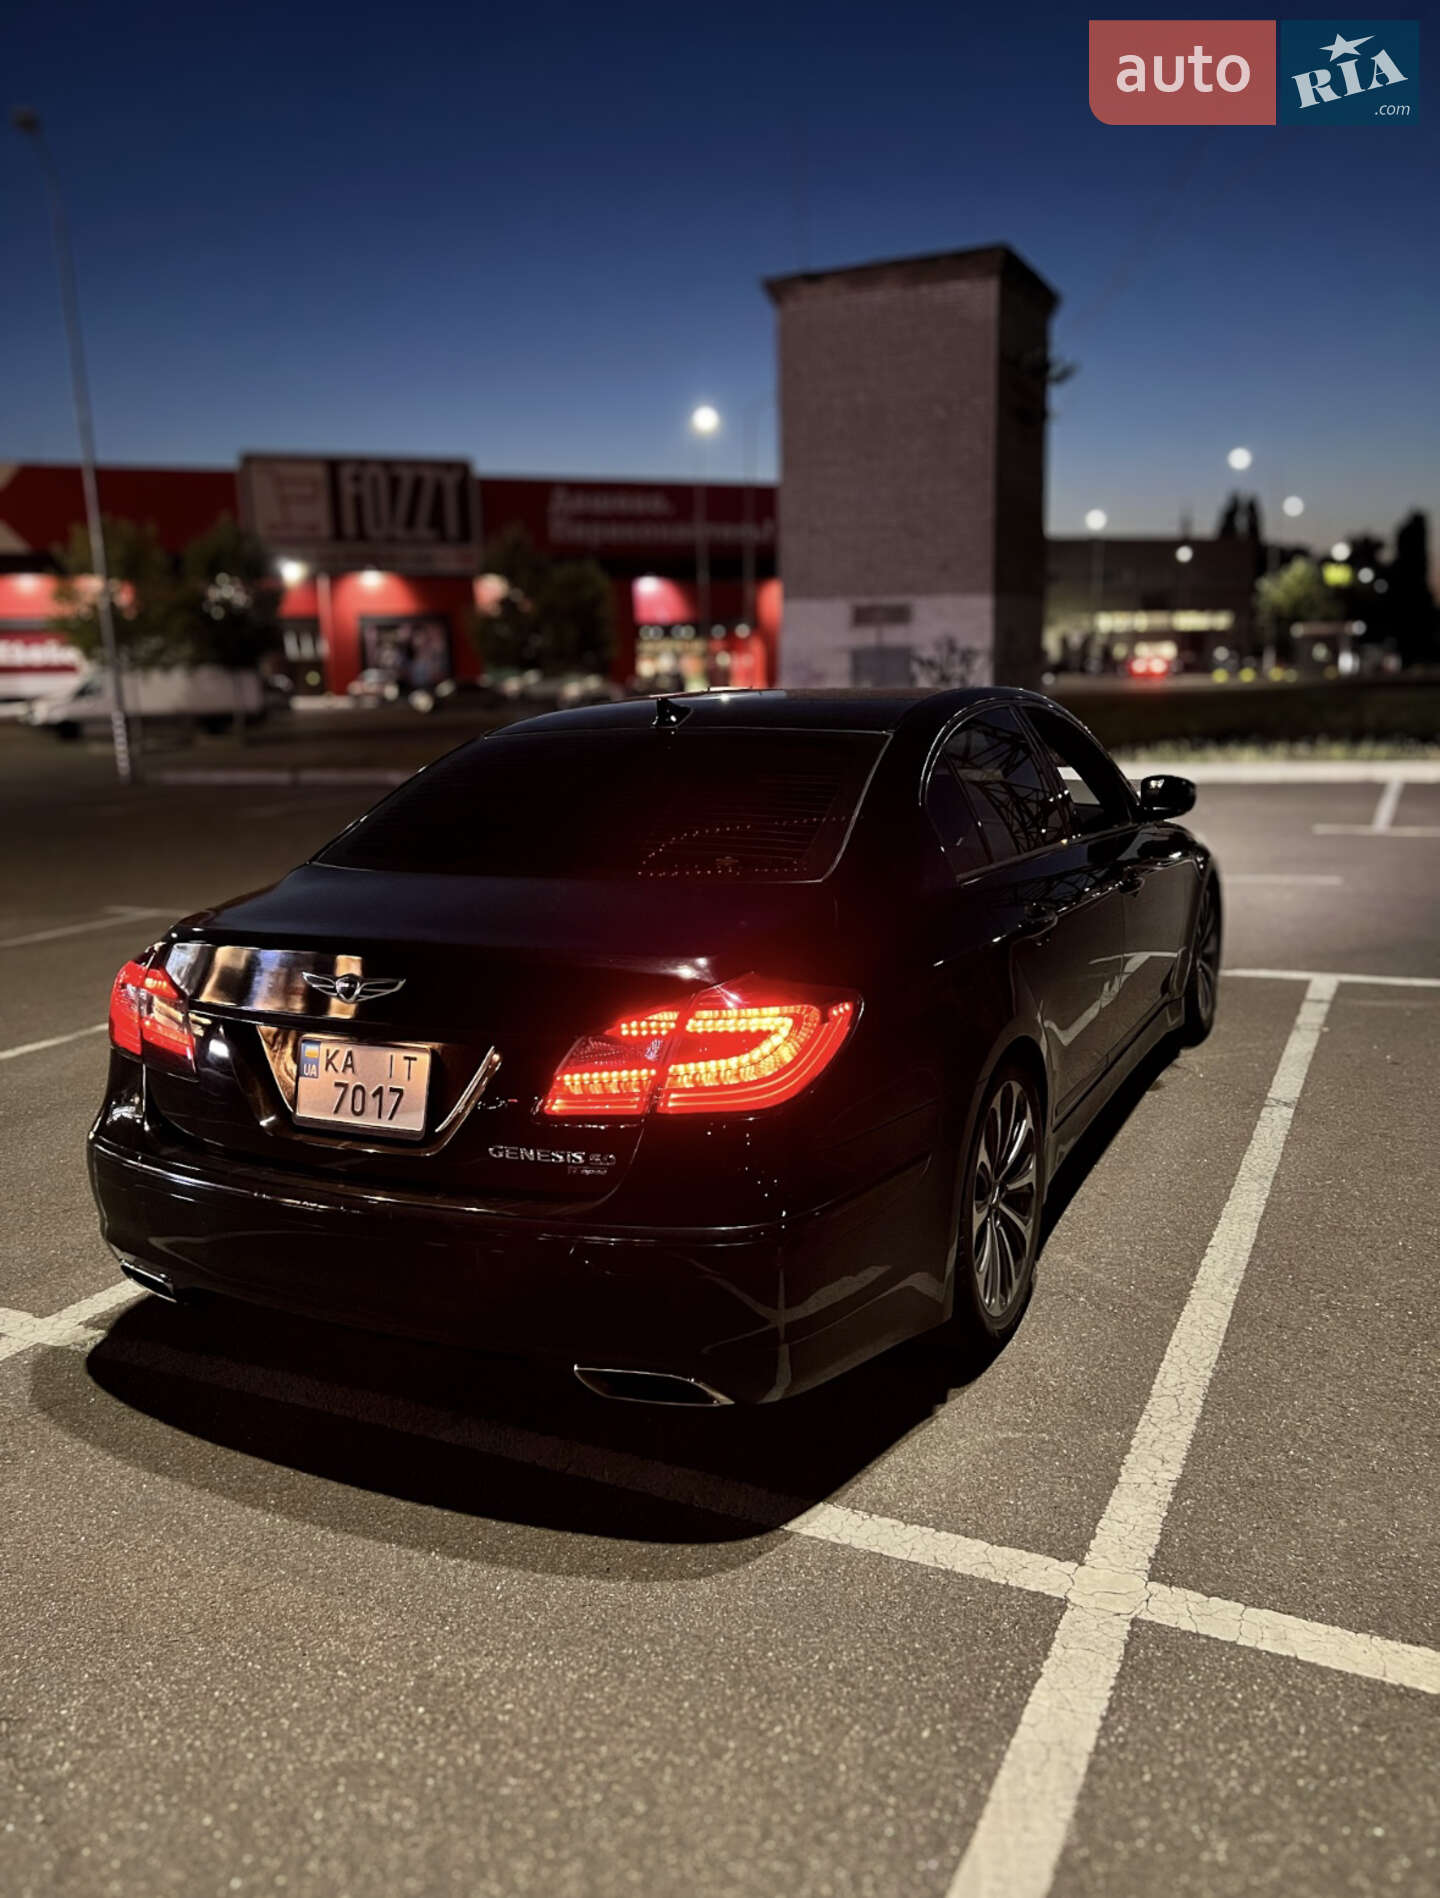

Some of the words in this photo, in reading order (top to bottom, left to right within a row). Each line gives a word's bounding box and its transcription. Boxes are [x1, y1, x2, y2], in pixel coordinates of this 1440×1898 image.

[338, 461, 466, 541] FOZZY
[303, 1063, 317, 1077] UA
[324, 1048, 356, 1075] KA
[333, 1081, 404, 1121] 7017
[488, 1145, 586, 1165] GENESIS
